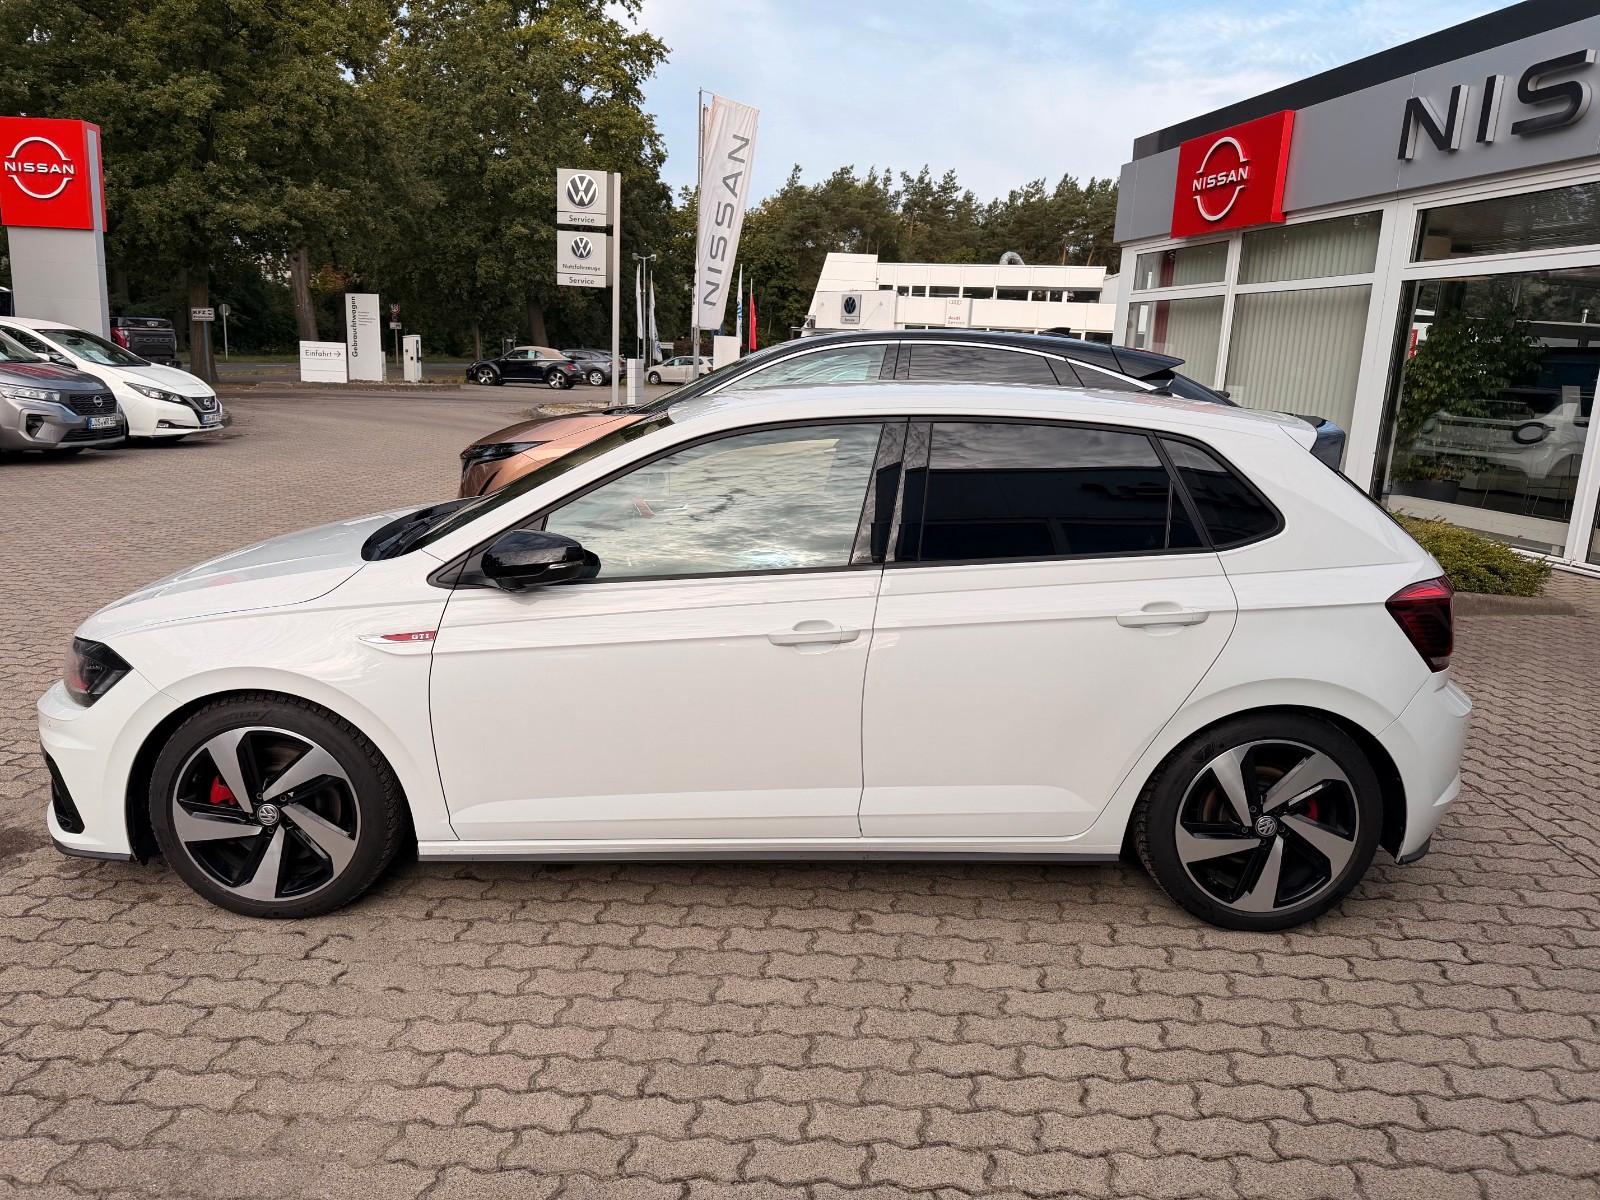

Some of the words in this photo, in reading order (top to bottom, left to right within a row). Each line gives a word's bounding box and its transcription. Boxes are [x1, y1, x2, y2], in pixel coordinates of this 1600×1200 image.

[1399, 49, 1597, 160] NIS
[3, 161, 75, 174] NISSAN
[1191, 166, 1249, 192] NISSAN
[566, 174, 598, 209] VW
[568, 214, 595, 224] Service
[702, 133, 750, 307] NISSAN
[571, 236, 592, 260] VW
[568, 276, 595, 285] Service
[305, 349, 332, 358] Einfahrt
